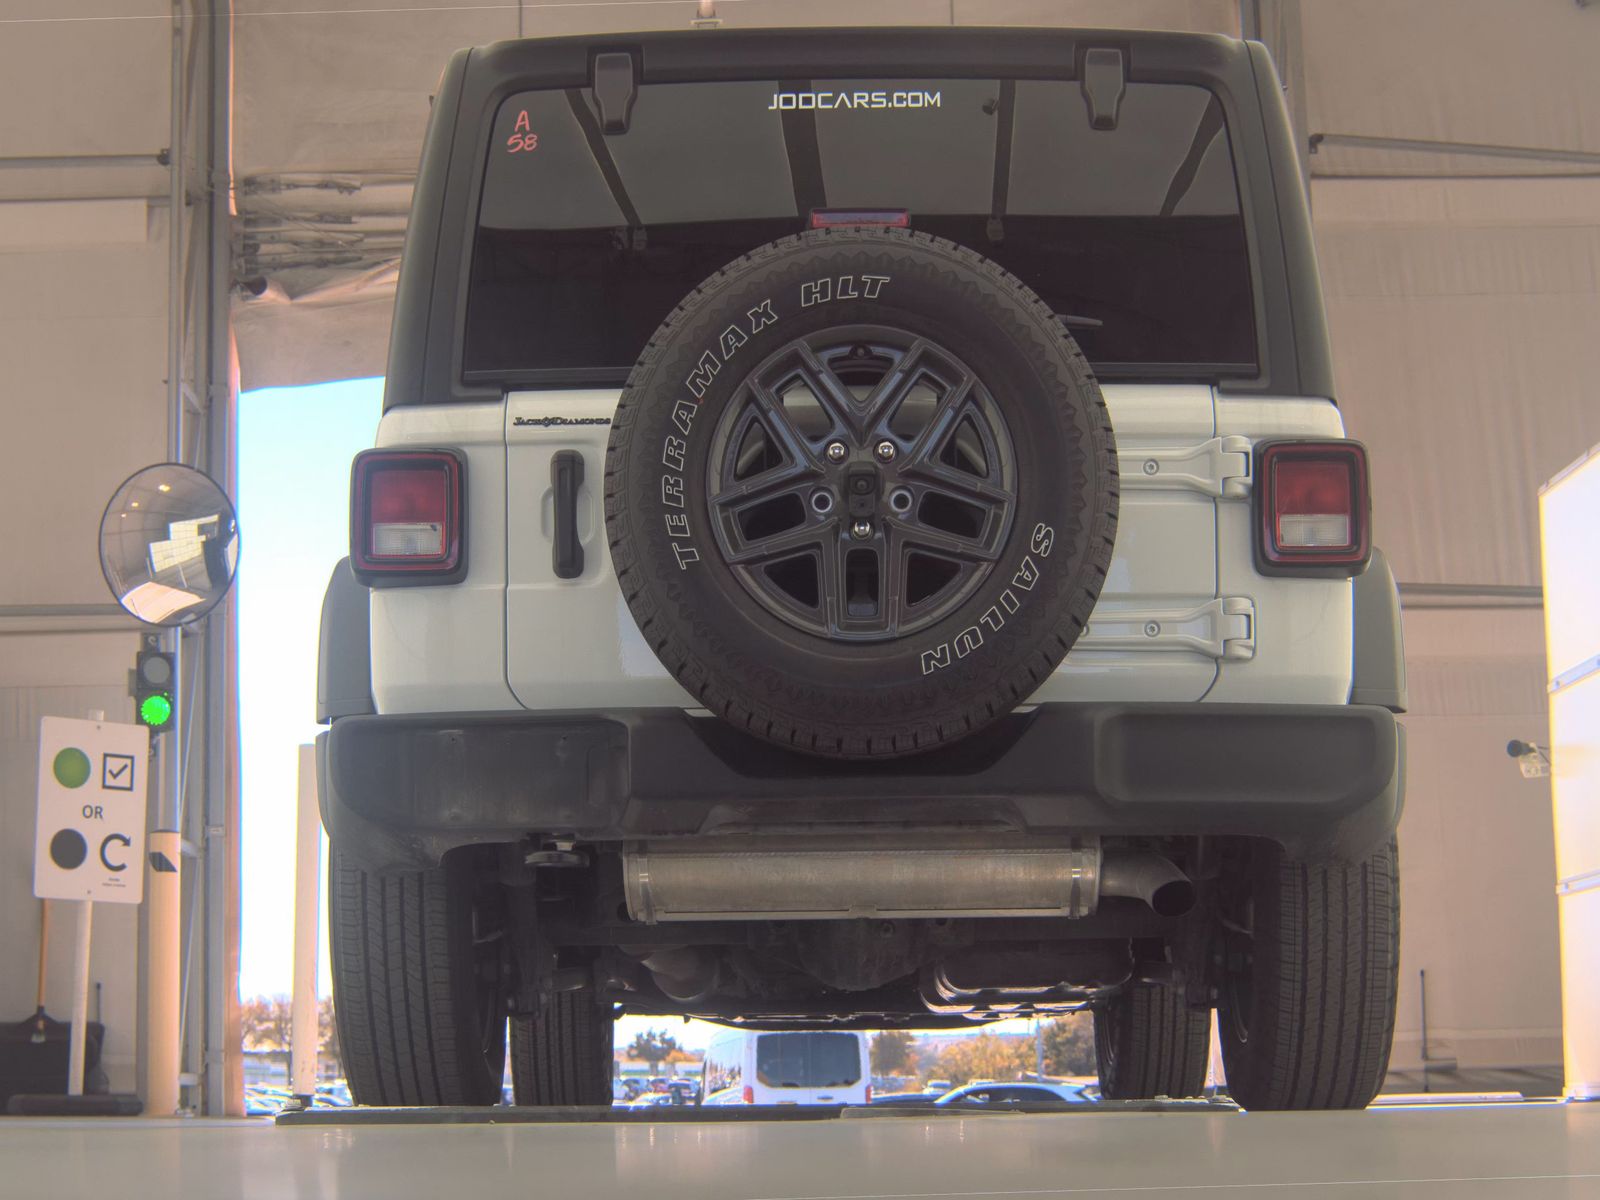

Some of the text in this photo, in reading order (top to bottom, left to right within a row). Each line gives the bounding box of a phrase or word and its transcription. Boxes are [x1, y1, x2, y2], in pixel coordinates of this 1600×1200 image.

[514, 110, 530, 132] A
[507, 133, 538, 153] 58
[662, 275, 890, 570] TERRAMAX HLT
[920, 522, 1054, 675] SAILUN
[82, 804, 105, 820] OR
